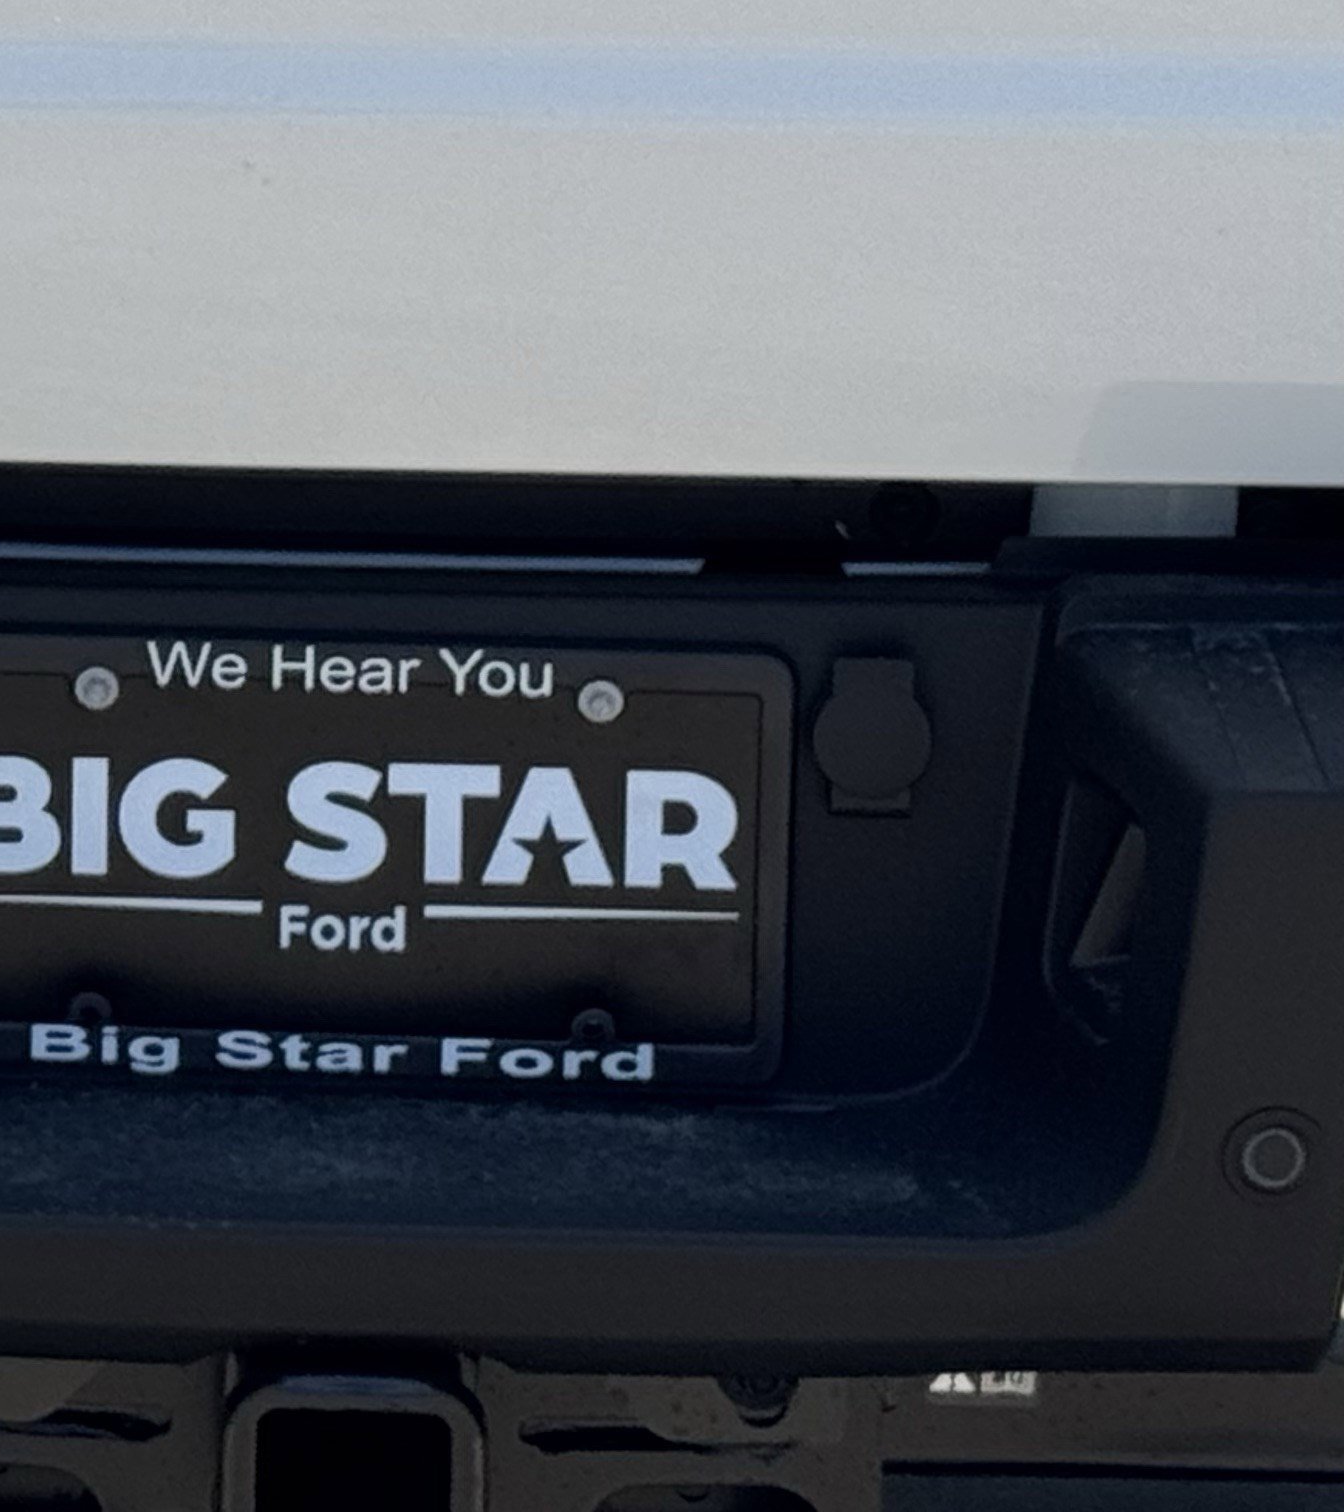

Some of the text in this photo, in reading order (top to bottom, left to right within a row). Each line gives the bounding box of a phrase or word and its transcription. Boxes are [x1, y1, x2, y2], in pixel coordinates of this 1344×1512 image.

[146, 639, 554, 699] We Hear You
[284, 761, 739, 891] STAR
[278, 904, 407, 952] Ford
[30, 1023, 654, 1080] Big Star Ford
